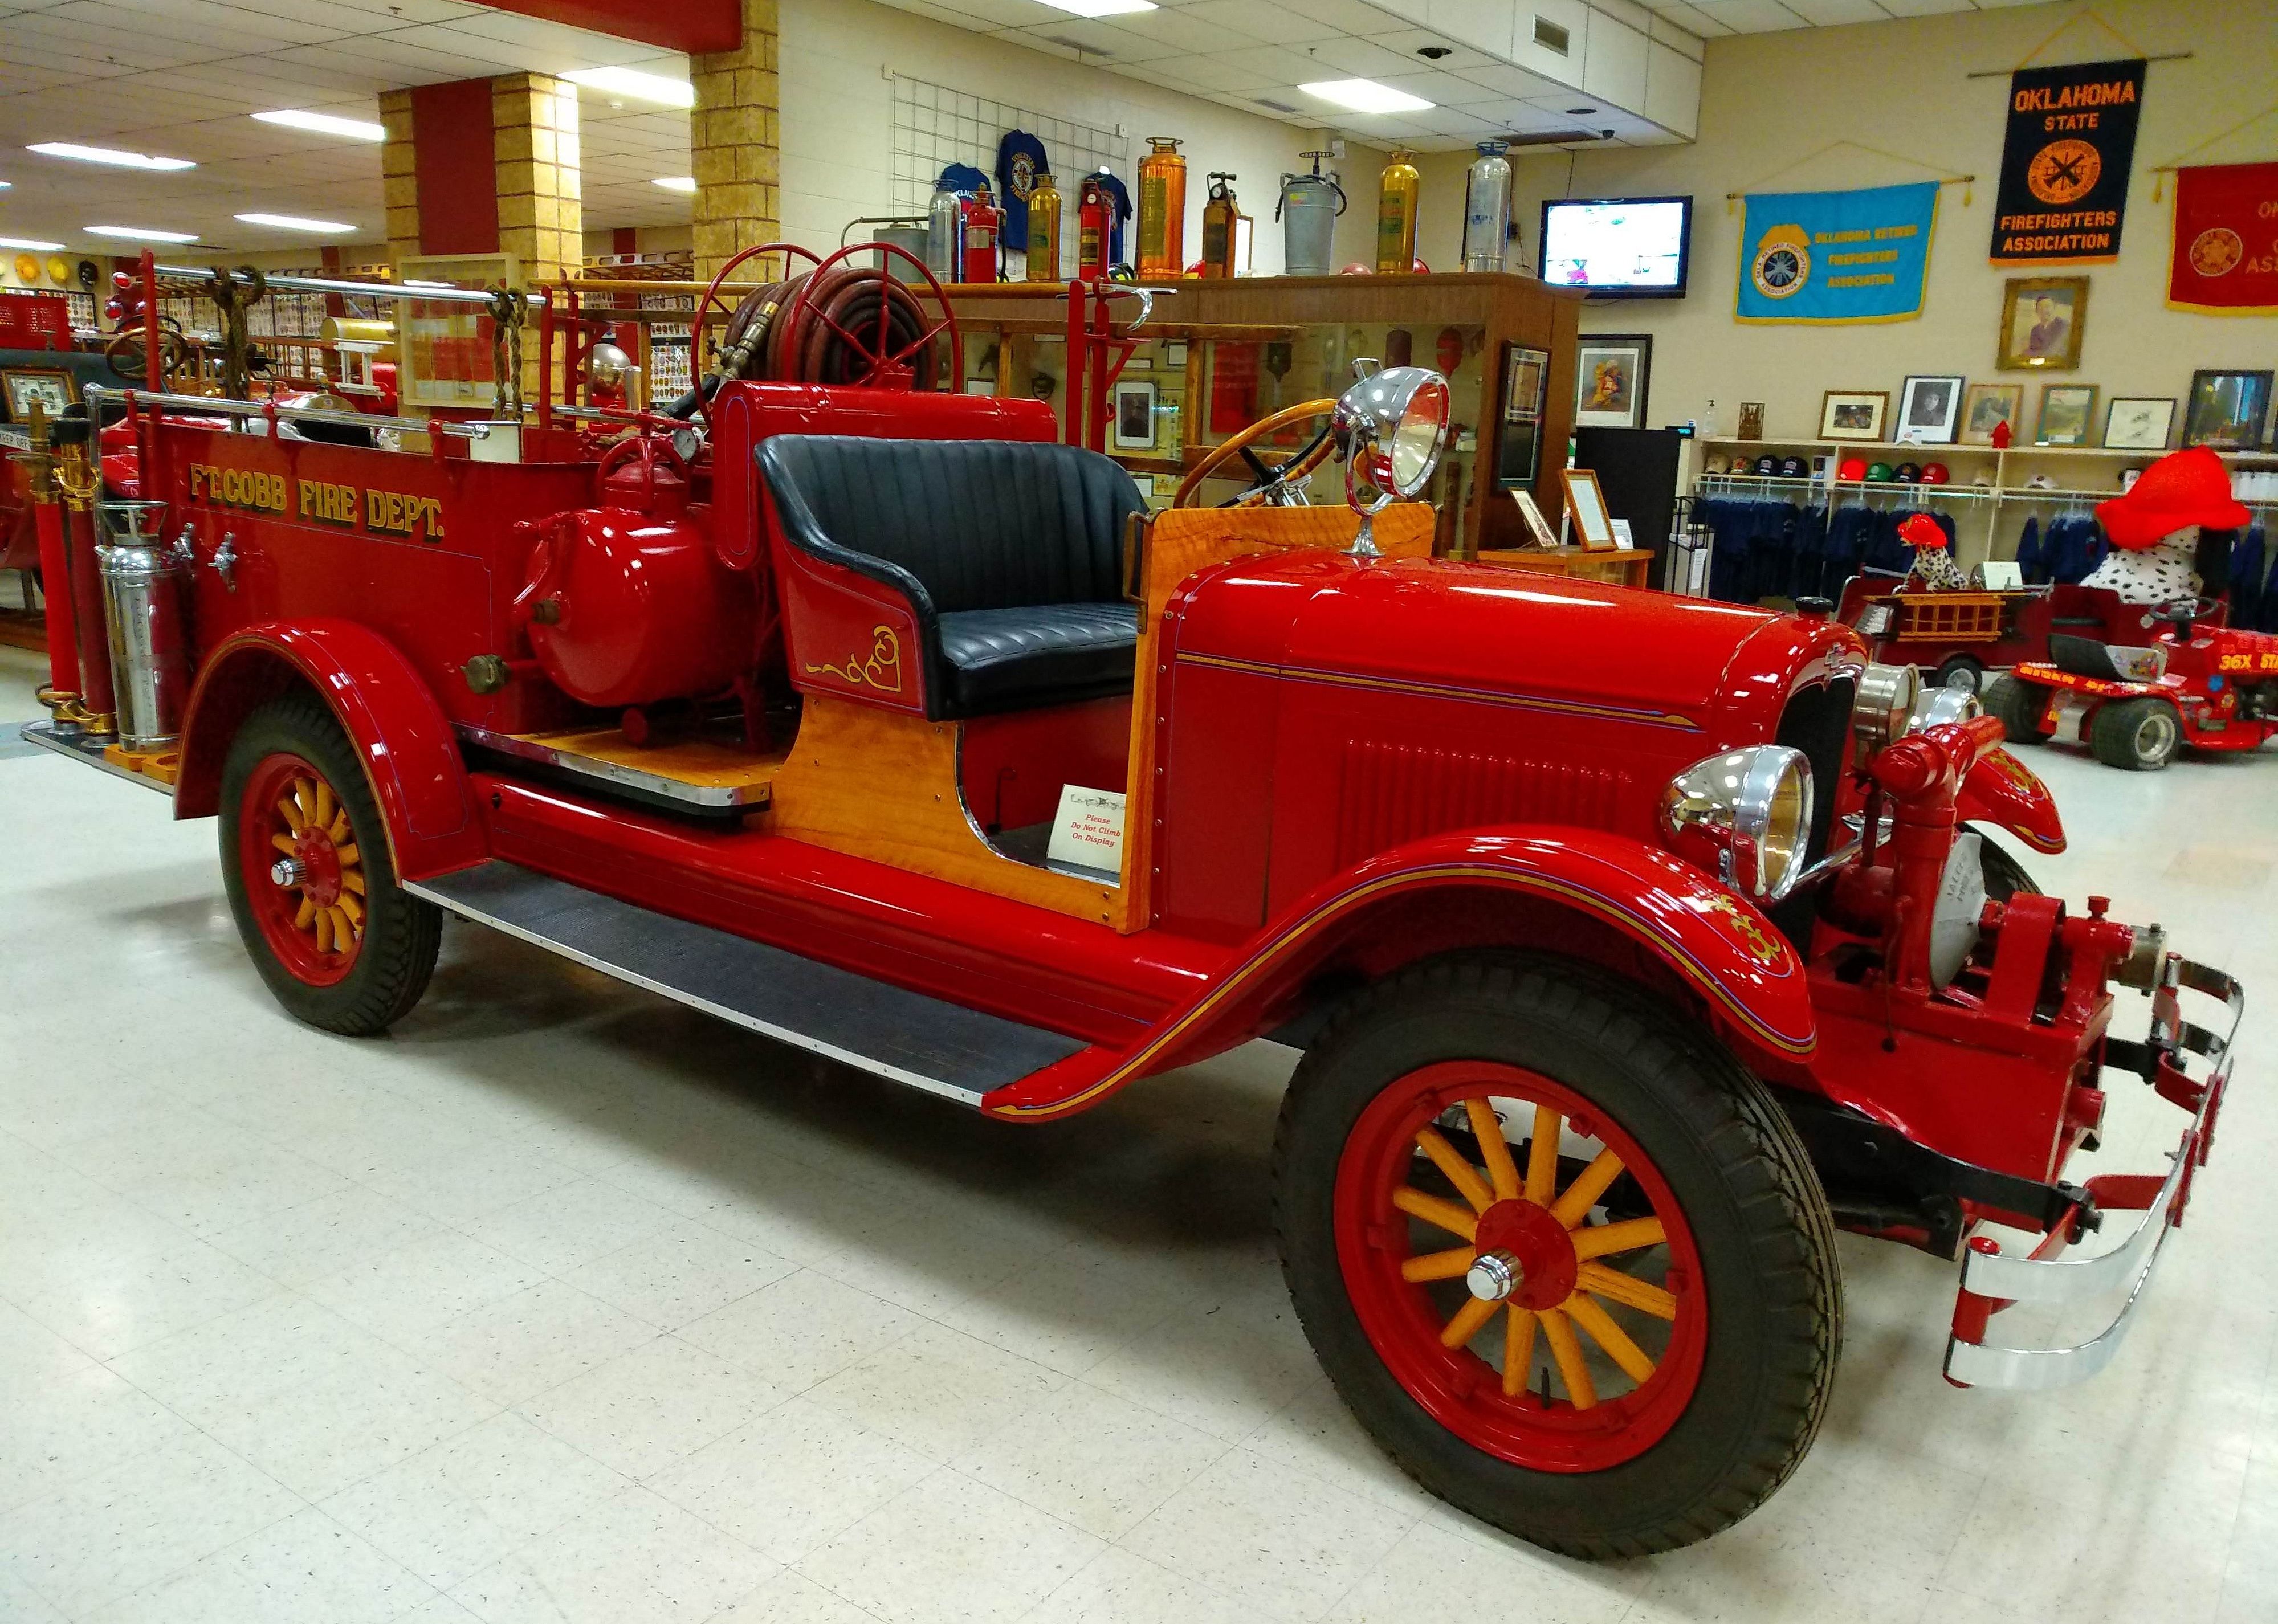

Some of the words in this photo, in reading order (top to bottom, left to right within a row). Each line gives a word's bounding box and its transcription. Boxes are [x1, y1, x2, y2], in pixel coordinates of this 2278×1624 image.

[2015, 81, 2135, 112] OKLAHOMA
[2044, 112, 2099, 132] STATE
[2000, 210, 2117, 230] FIREFIGHTERS
[2002, 232, 2110, 252] ASSOCIATION
[298, 479, 358, 523] FIRE
[366, 489, 445, 537] DEPT.
[1085, 814, 1111, 824] Please
[1085, 835, 1115, 847] Display
[1098, 827, 1121, 837] Climb
